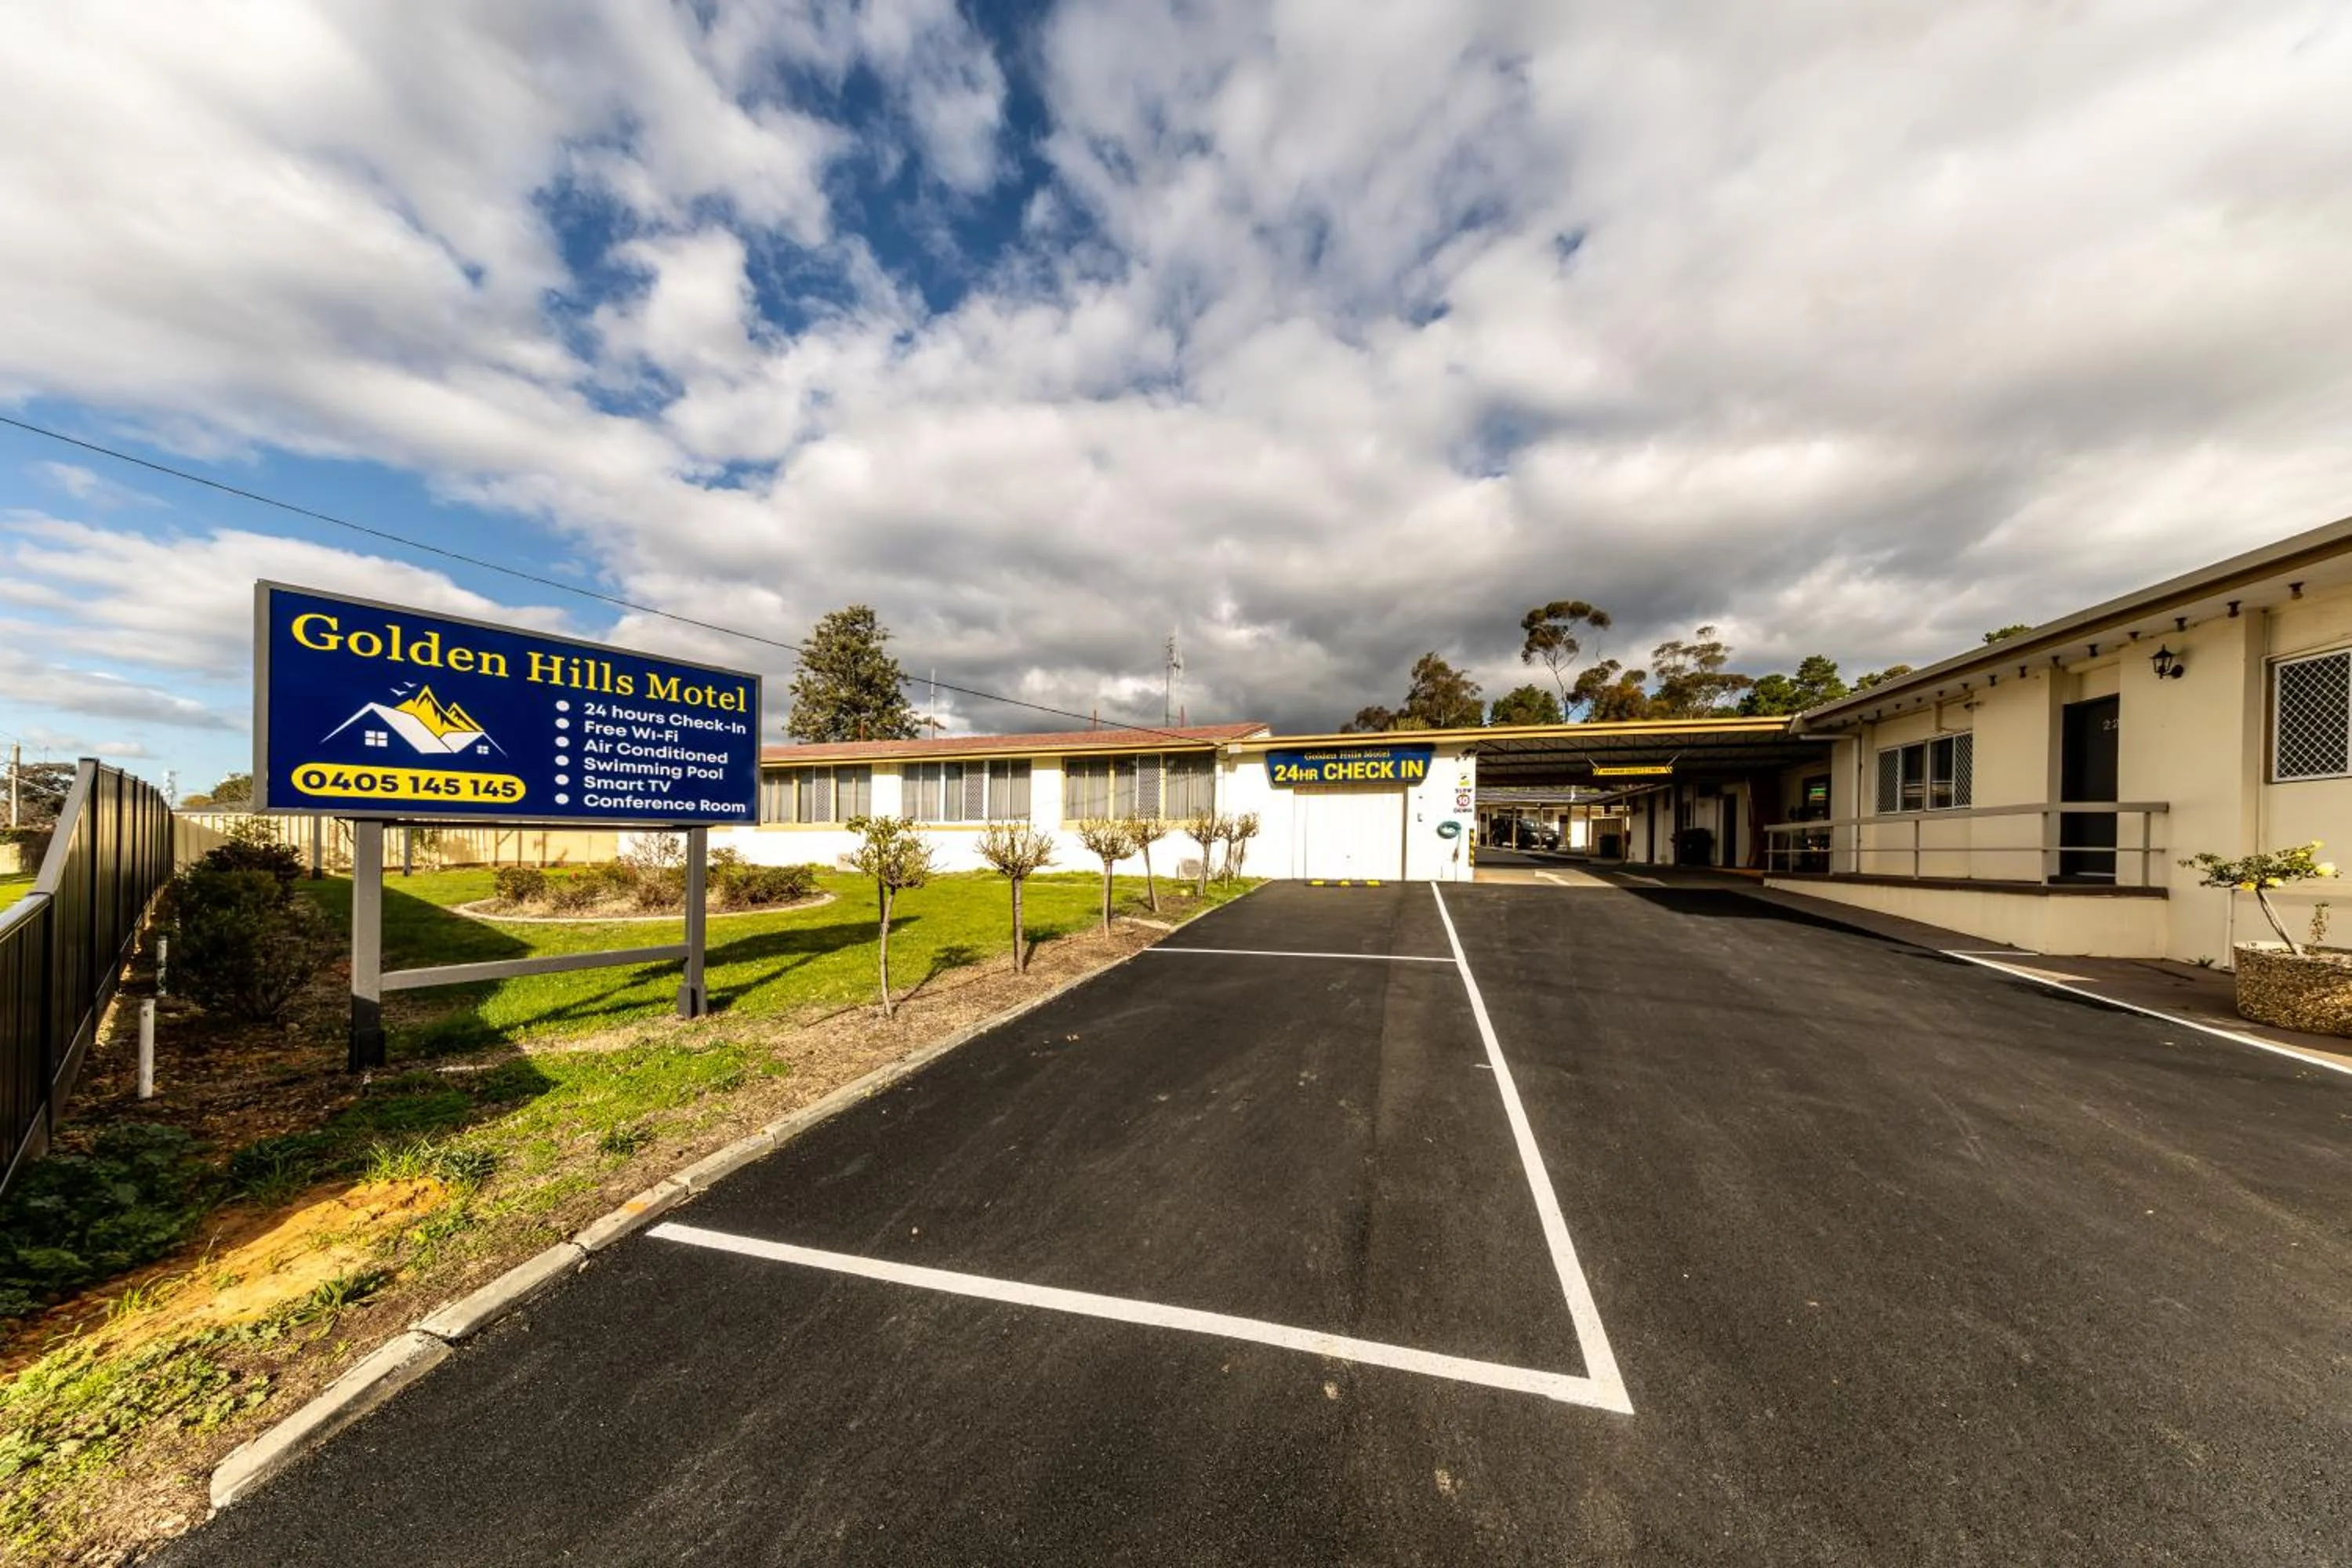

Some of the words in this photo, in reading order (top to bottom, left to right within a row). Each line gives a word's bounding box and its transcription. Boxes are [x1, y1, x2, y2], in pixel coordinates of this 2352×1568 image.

[292, 613, 510, 677] Golden
[527, 652, 633, 695] Hills
[646, 673, 746, 712] Motel
[584, 702, 607, 717] 24
[612, 706, 665, 724] hours
[669, 713, 746, 734] Check-In
[584, 720, 627, 736] Free
[631, 726, 678, 742] Wi-Fi
[584, 739, 612, 753] Air
[616, 742, 728, 764] Conditioned
[583, 757, 682, 779] Swimming
[687, 766, 724, 779] Pool
[1323, 760, 1394, 780] CHECK
[1400, 760, 1423, 779] IN
[302, 770, 399, 793] 0405
[408, 775, 460, 795] 145
[470, 779, 517, 797] 145
[583, 775, 644, 791] Smart
[648, 780, 671, 793] TV
[583, 794, 695, 810] Conference
[700, 800, 746, 812] Room
